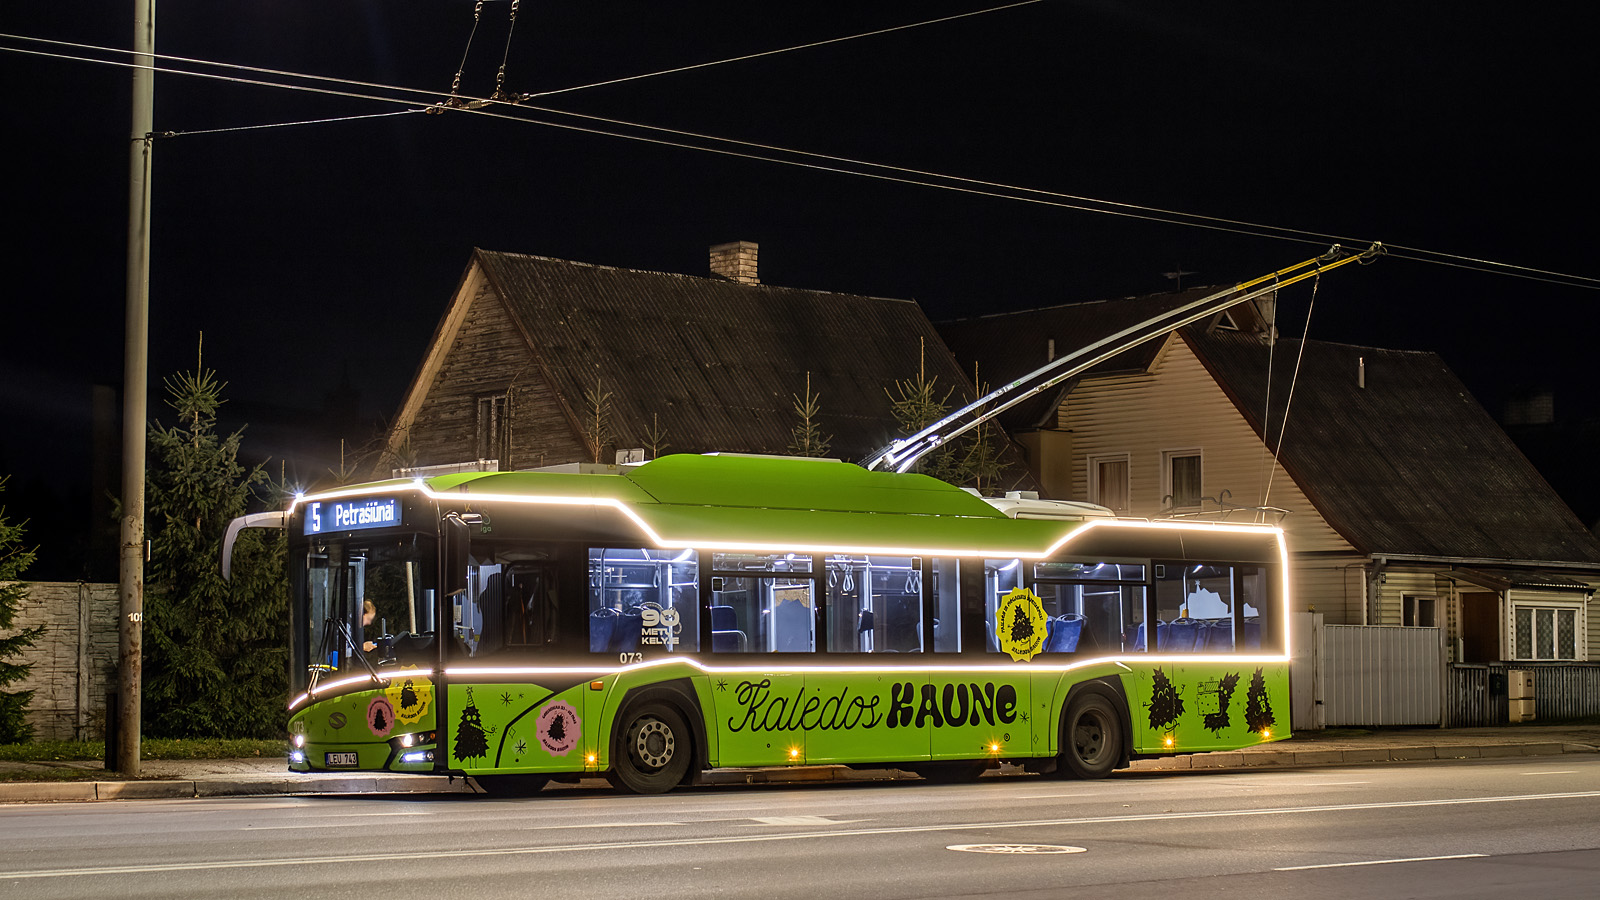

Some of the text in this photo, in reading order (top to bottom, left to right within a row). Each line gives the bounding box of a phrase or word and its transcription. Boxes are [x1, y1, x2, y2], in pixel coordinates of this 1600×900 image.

[312, 502, 321, 532] 5
[641, 609, 680, 627] 90
[641, 637, 680, 645] KELYJE
[619, 652, 643, 664] 073
[727, 678, 883, 732] Kalėdos
[329, 754, 356, 764] LEU 743
